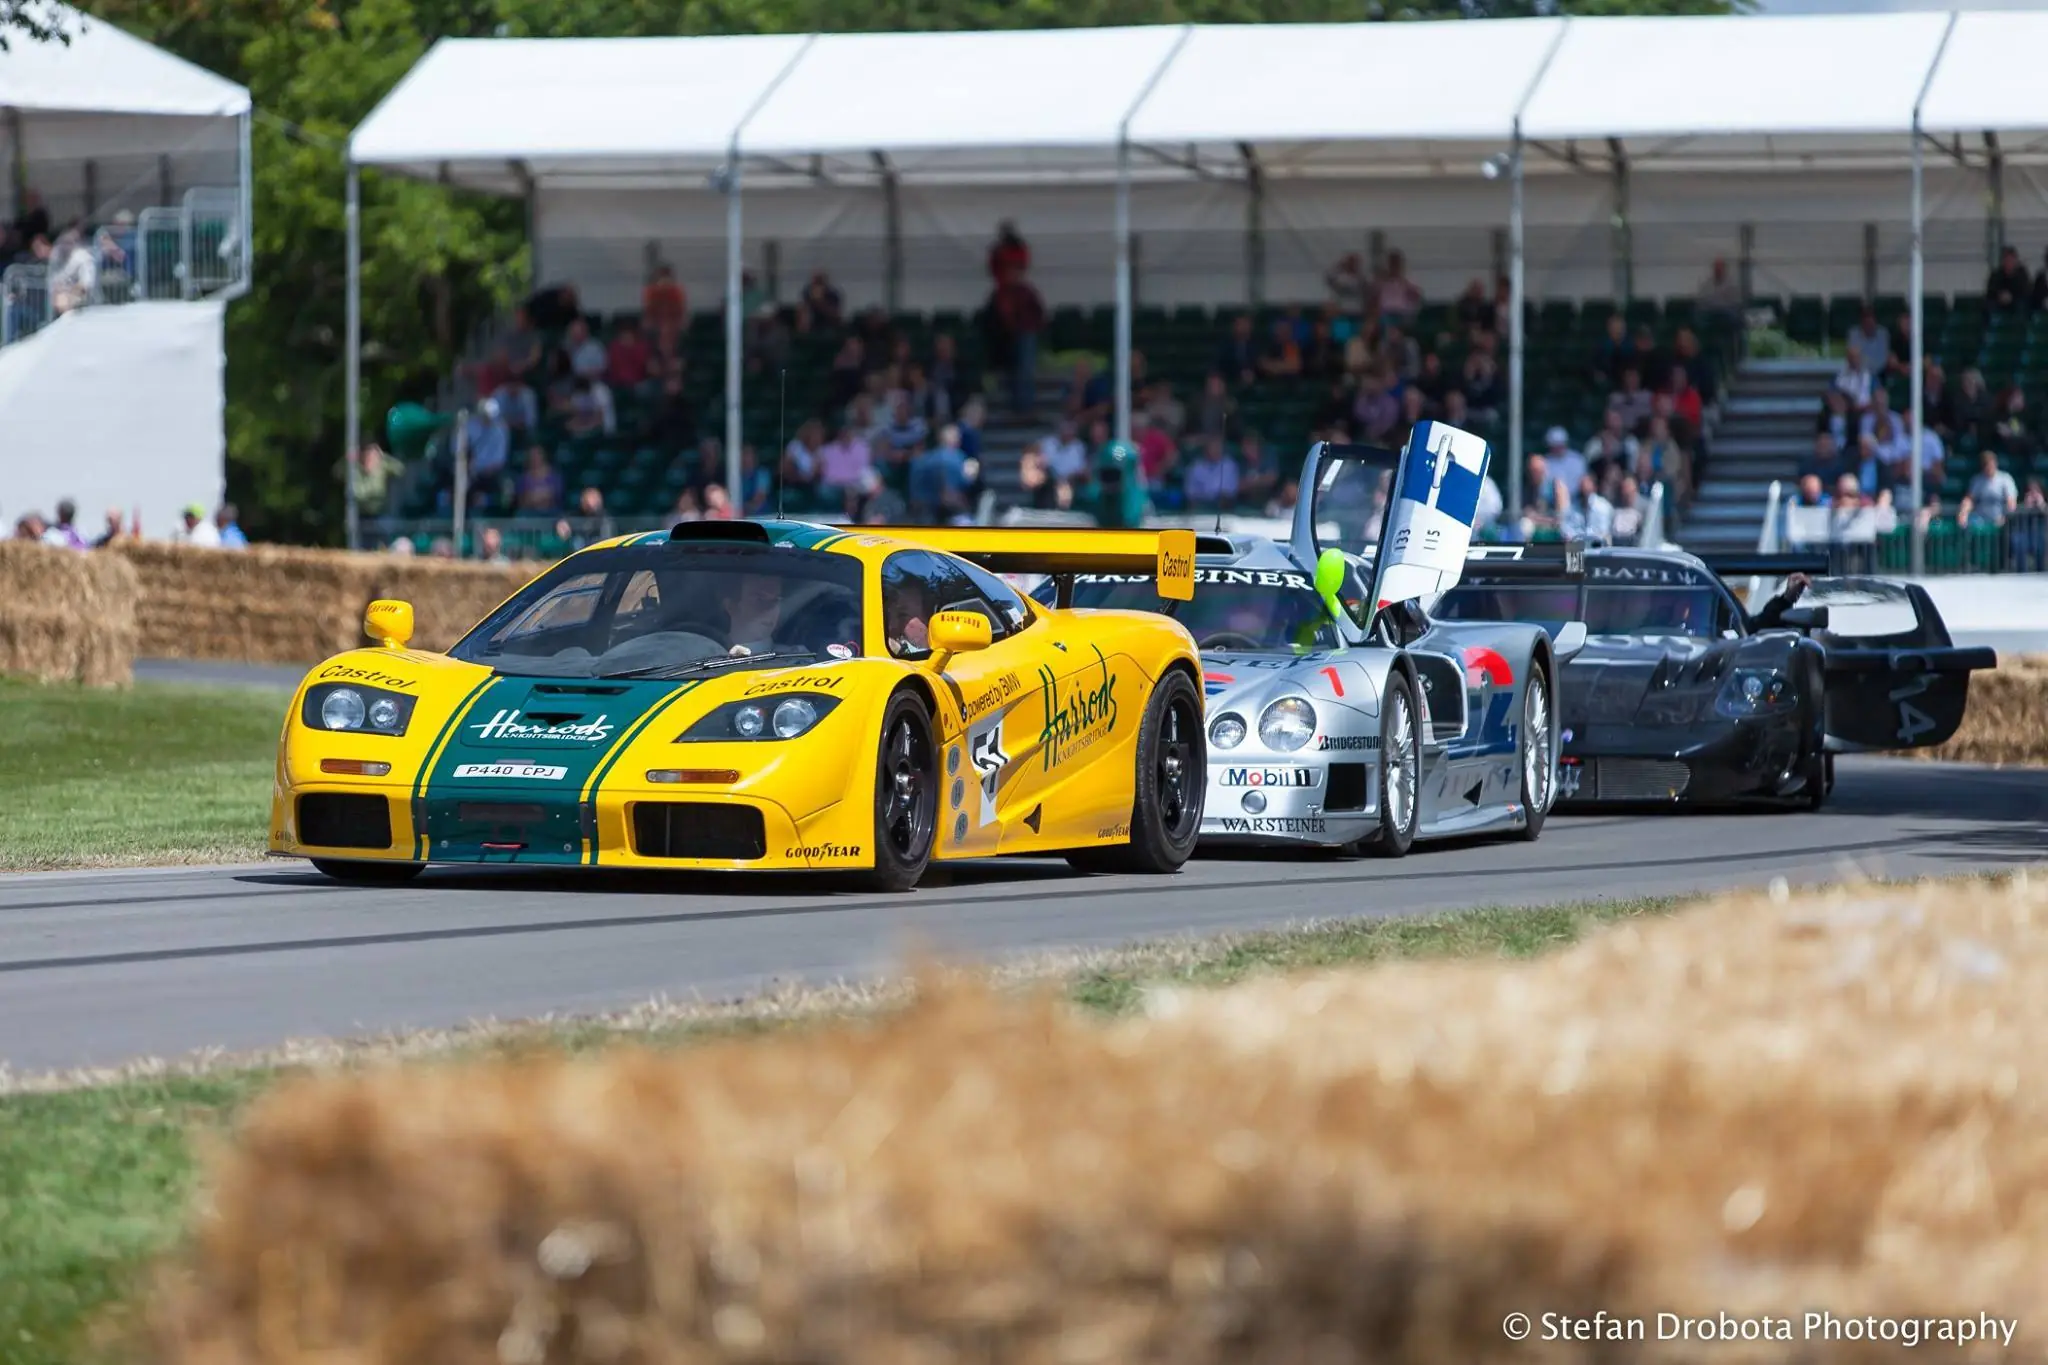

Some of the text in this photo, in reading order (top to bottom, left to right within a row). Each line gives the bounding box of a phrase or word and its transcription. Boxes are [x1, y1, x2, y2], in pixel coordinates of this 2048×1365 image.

[1163, 551, 1192, 578] Castrol
[320, 665, 417, 689] Castrol
[743, 676, 844, 696] Castrol
[967, 686, 995, 724] powered
[998, 671, 1021, 696] BMW
[1039, 643, 1118, 773] Harrods
[469, 709, 615, 742] Harrods
[1318, 735, 1382, 751] BRIDGESTON
[466, 765, 555, 777] P440 CPJ
[1228, 768, 1290, 786] Mobil
[1221, 818, 1326, 833] WARSTEINER
